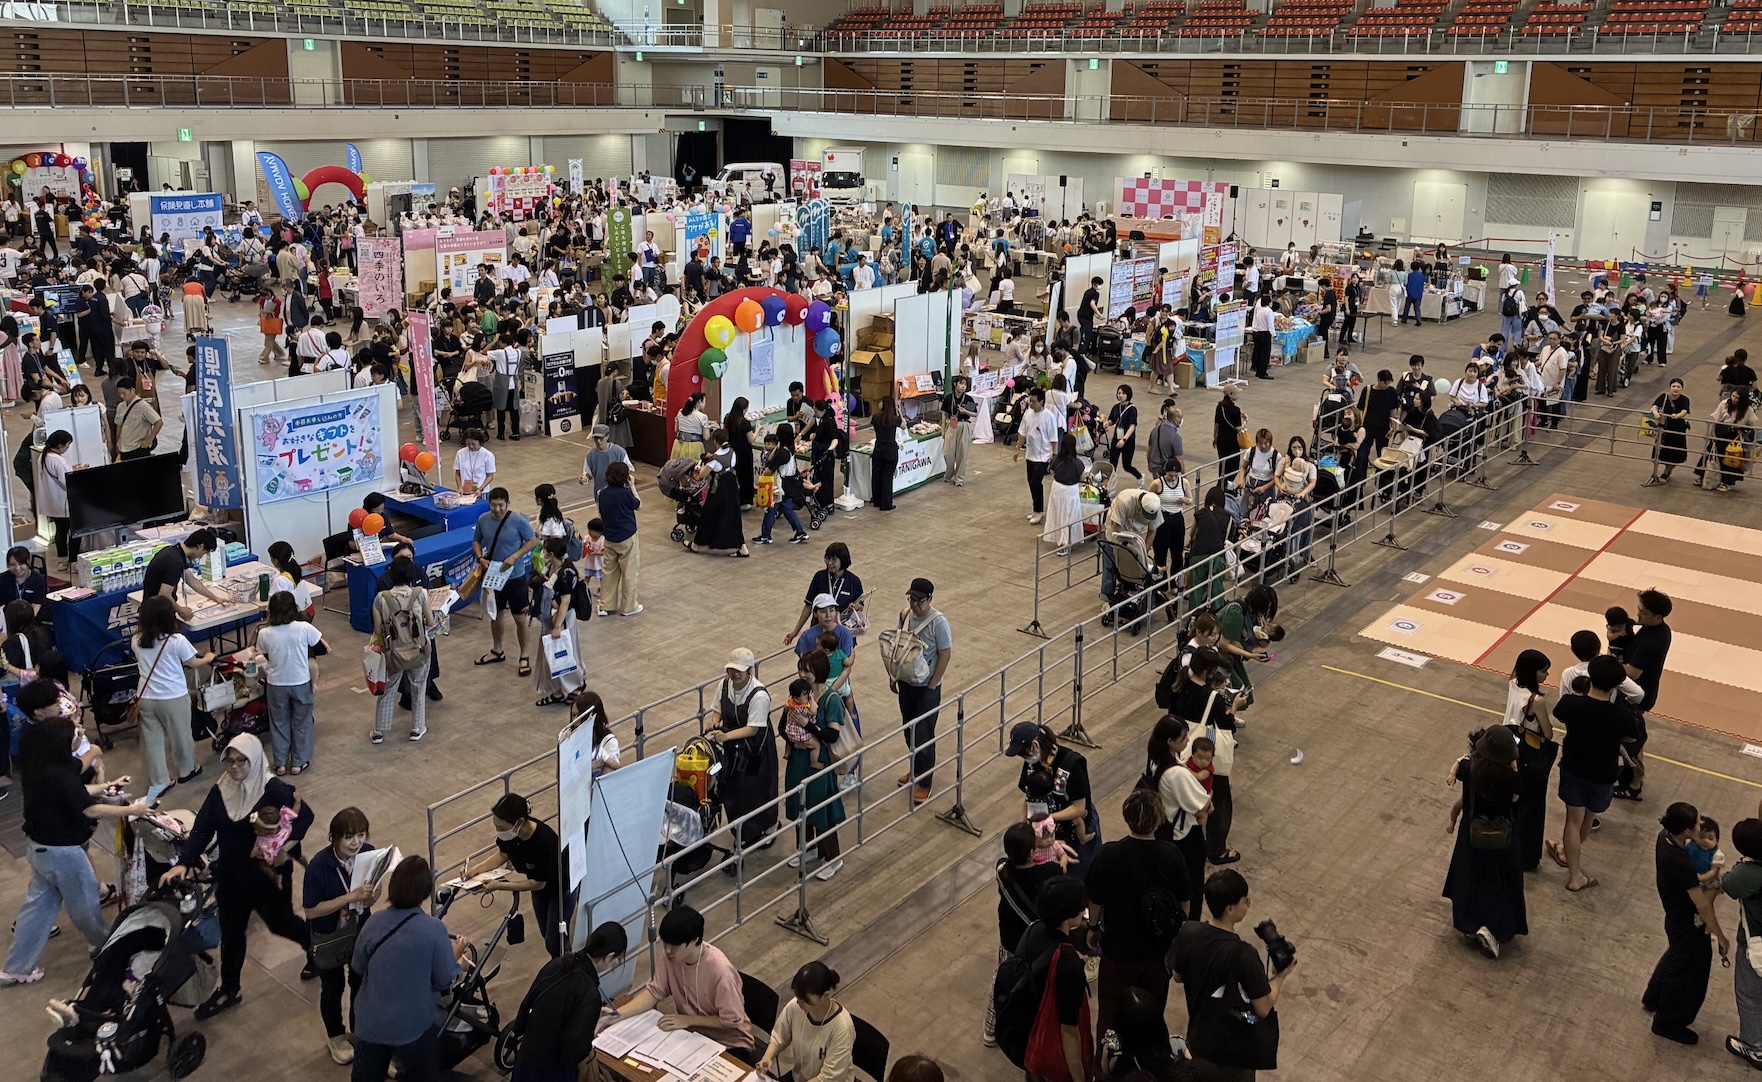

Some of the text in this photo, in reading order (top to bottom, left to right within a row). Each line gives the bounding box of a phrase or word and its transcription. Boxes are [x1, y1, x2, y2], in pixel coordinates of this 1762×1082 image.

[160, 198, 214, 211] 保険見直し本舗
[373, 251, 385, 304] 四季のいろ
[279, 435, 365, 468] プレゼント!
[898, 456, 932, 476] TANIGAWA
[819, 1047, 827, 1060] H
